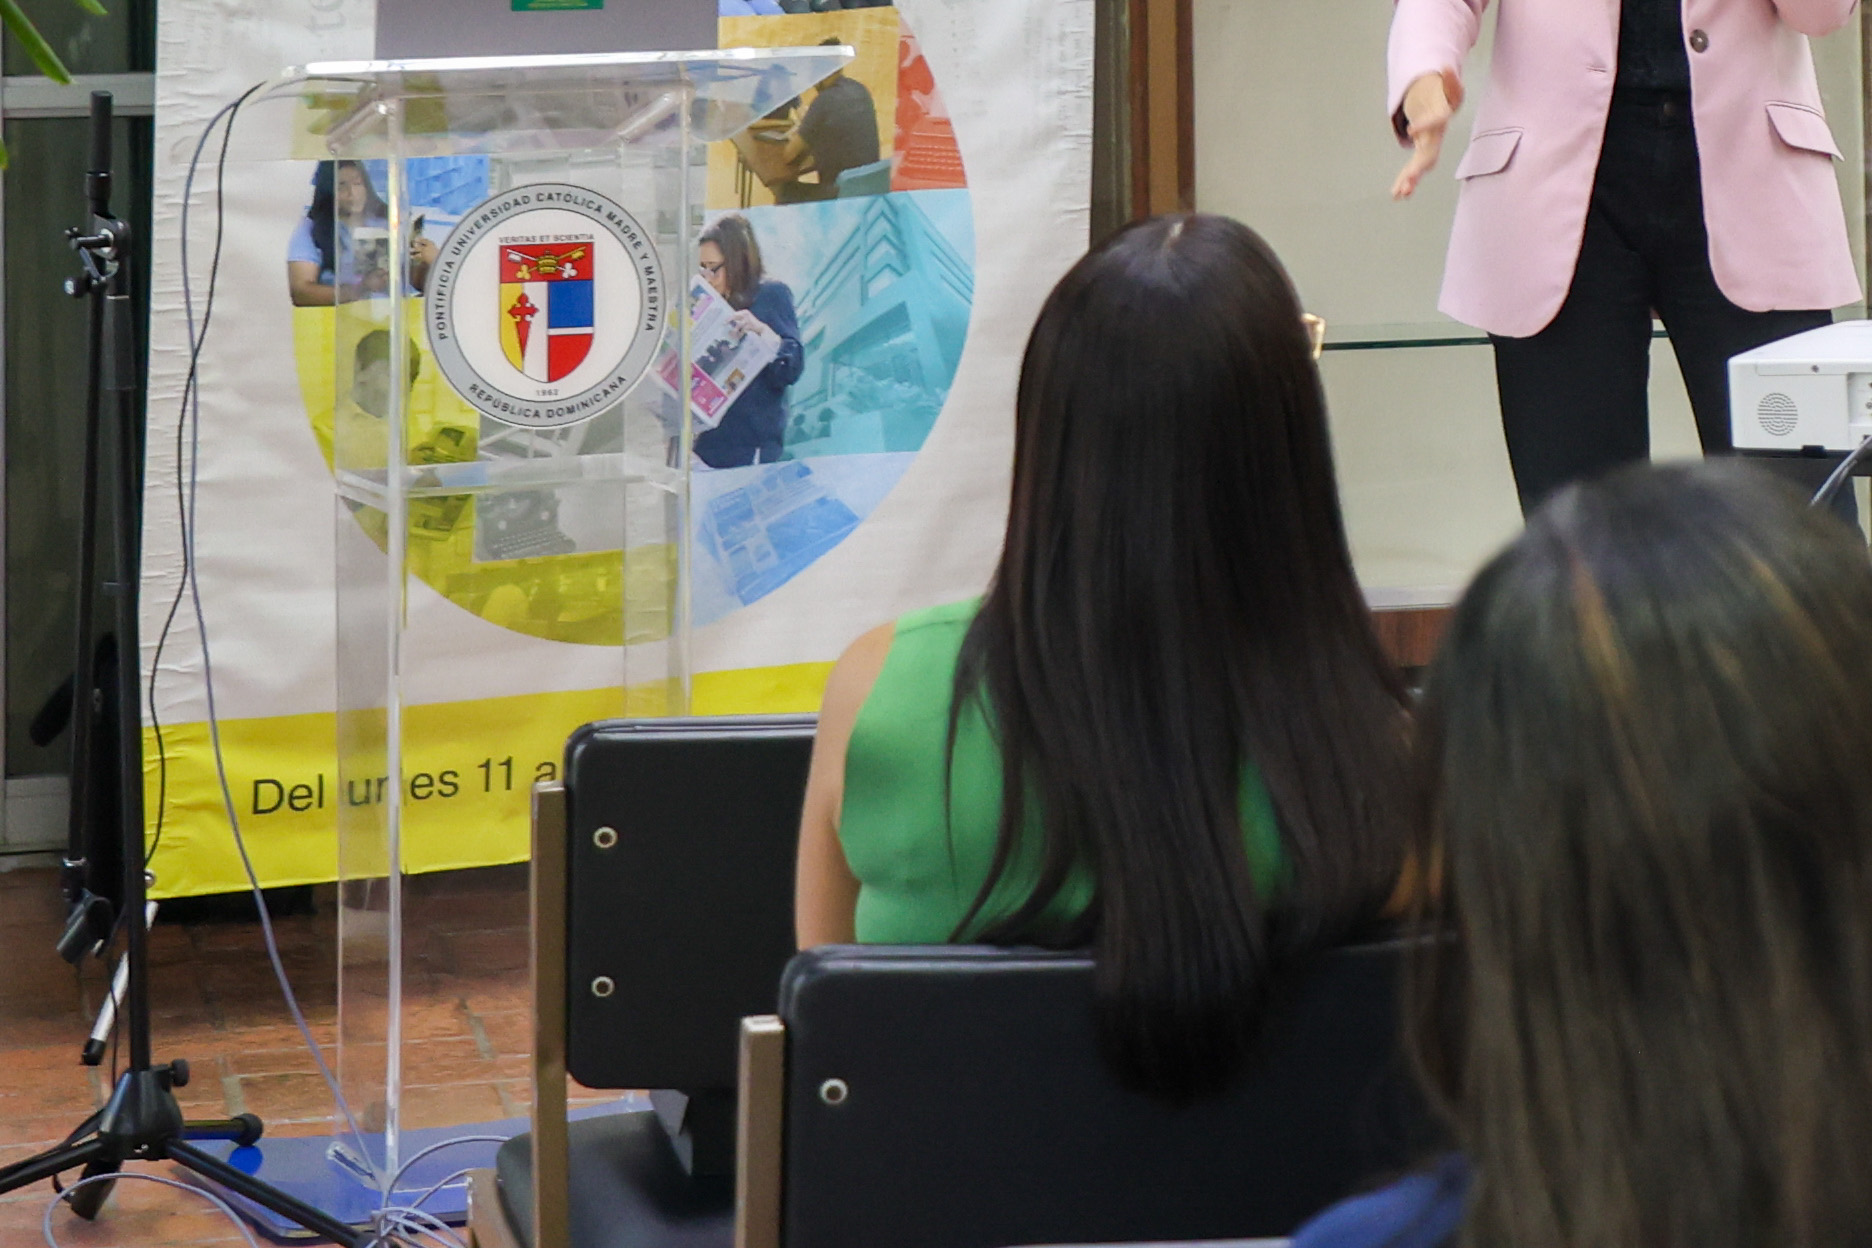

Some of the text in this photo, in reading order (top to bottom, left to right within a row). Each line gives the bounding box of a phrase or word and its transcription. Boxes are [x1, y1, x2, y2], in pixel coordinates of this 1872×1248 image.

[432, 190, 658, 340] PONTIFICIA UNIVERSIDAD CATÓLICA MADRE Y MAESTRA
[468, 375, 627, 420] REPÚBLICA DOMINICANA
[252, 773, 325, 815] Del
[346, 769, 459, 807] unes
[477, 756, 513, 792] 11
